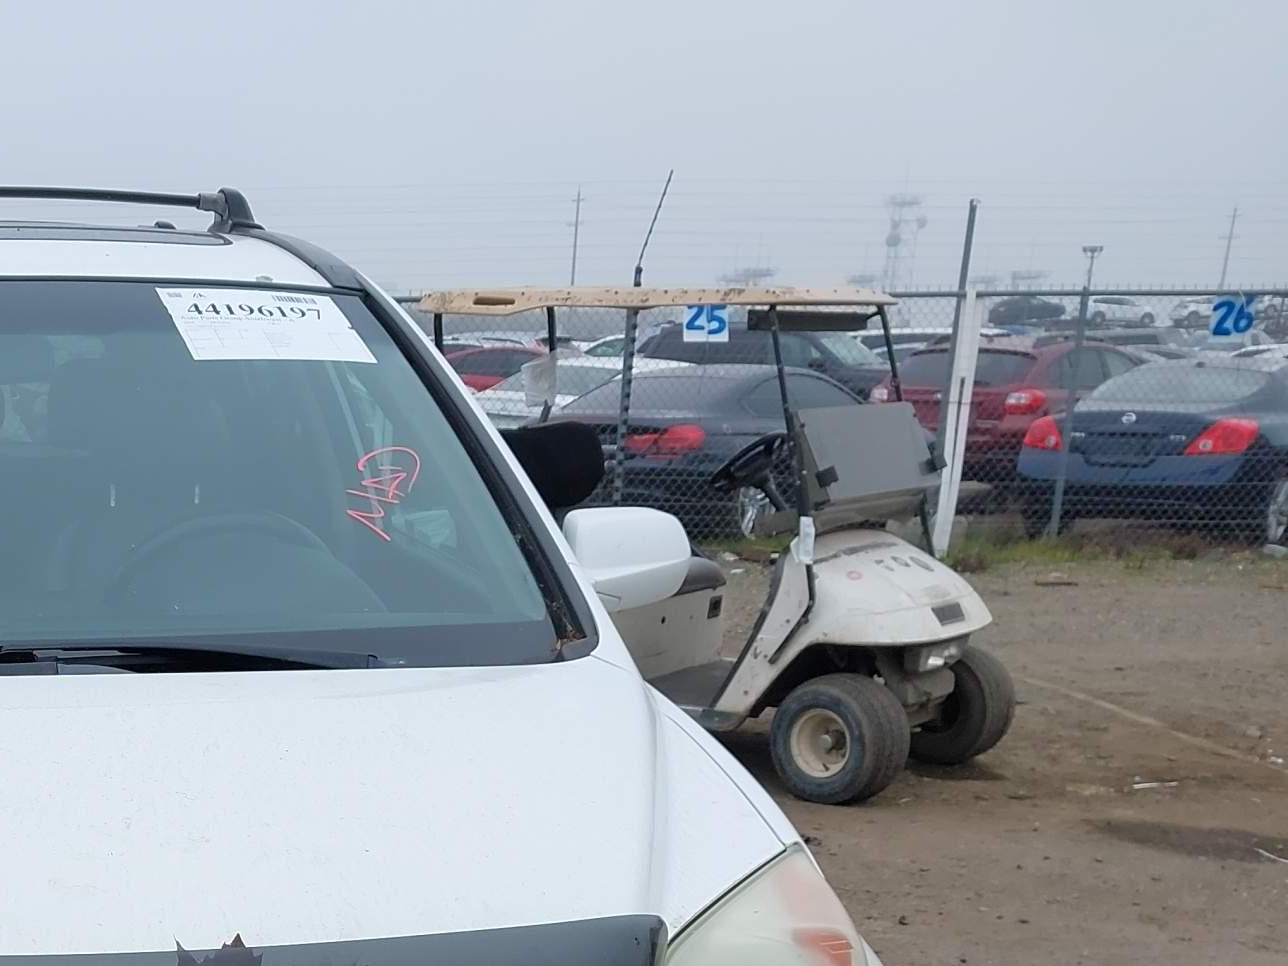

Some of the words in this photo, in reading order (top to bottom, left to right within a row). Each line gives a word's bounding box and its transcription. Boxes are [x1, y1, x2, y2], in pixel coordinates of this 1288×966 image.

[187, 302, 320, 320] 44196197
[686, 304, 727, 335] 25
[1212, 294, 1255, 336] 26
